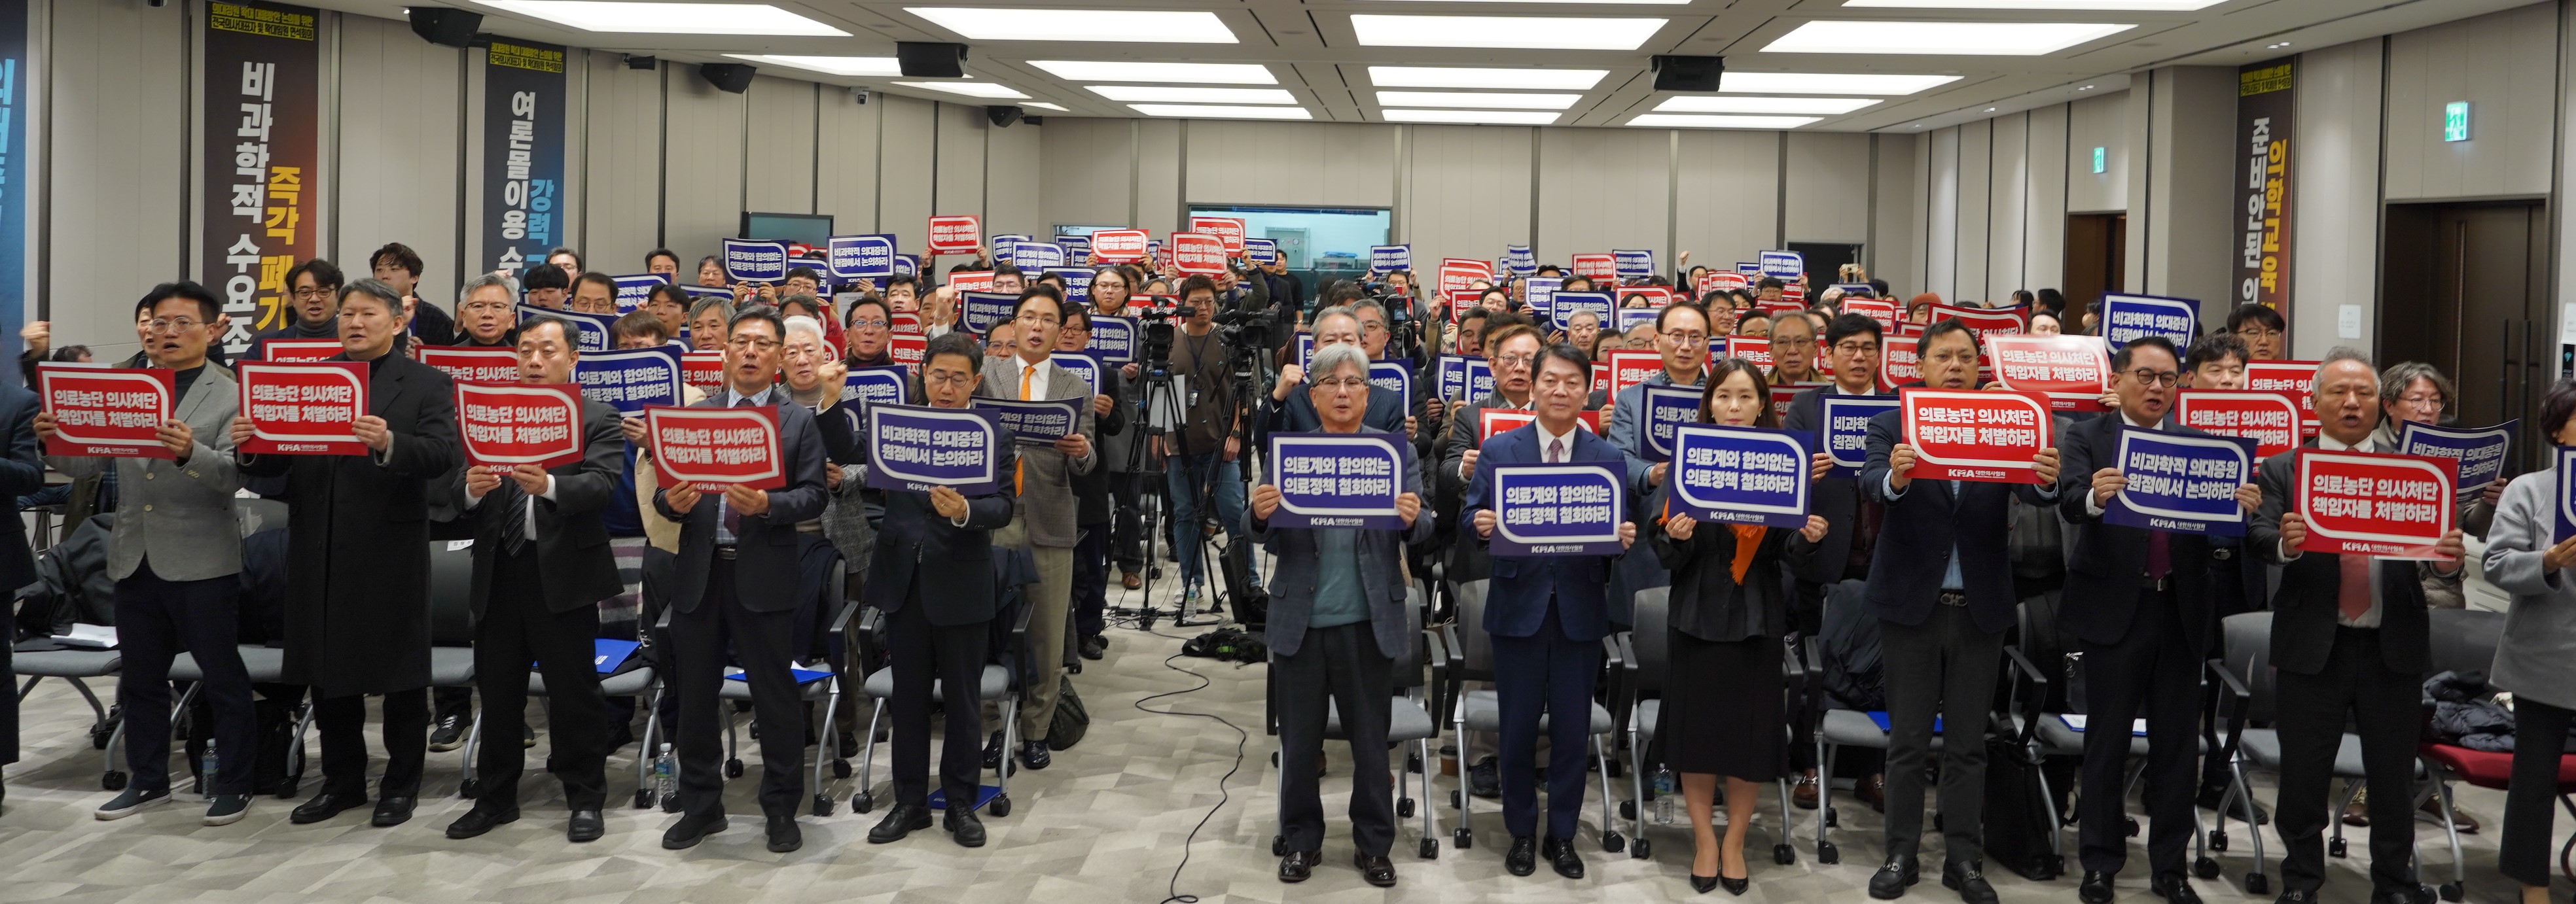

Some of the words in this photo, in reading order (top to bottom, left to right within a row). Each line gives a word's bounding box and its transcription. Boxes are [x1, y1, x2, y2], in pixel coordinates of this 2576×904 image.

[231, 61, 275, 223] 비과학적
[501, 91, 536, 240] 여론몰이용
[2244, 116, 2270, 268] 준비안된
[265, 166, 300, 245] 즉각
[528, 179, 554, 246] 강력
[2260, 139, 2287, 294] 의학교육
[730, 251, 755, 261] 의료계와
[756, 252, 782, 262] 합의없는
[834, 247, 861, 256] 비과학적
[861, 246, 888, 256] 의대증원
[730, 261, 755, 271] 의료정책
[756, 262, 782, 272] 철회하라
[834, 258, 861, 268] 원점에서
[861, 256, 888, 267] 논의하라
[222, 234, 260, 365] 수요조
[970, 302, 998, 315] 비과학적
[2112, 311, 2155, 328] 비과학적
[2155, 314, 2189, 332] 의대증원
[1100, 328, 1128, 339] 합의없는
[1889, 351, 1917, 364] 의료농
[2002, 350, 2048, 364] 의료농단
[2050, 351, 2095, 365] 의사처단
[578, 369, 622, 386] 의료계와
[624, 366, 669, 383] 합의없는
[694, 370, 723, 383] 의사처
[2005, 366, 2050, 381] 책임자를
[2052, 367, 2098, 382] 처벌하라
[252, 384, 300, 402] 의료농단
[301, 385, 352, 403] 의사처단
[625, 382, 670, 401] 철회하라
[2251, 378, 2294, 391] 의료농단
[54, 390, 103, 408] 의료농단
[106, 391, 158, 409] 의사처단
[56, 409, 107, 426] 책임자를
[108, 411, 158, 428] 처벌하라
[253, 404, 300, 422] 책임자를
[302, 406, 352, 423] 처벌하라
[467, 404, 512, 423] 의료농단
[516, 406, 567, 423] 의사처단
[1024, 413, 1067, 425] 합의없는
[1918, 408, 1975, 424] 의료농단
[1978, 409, 2035, 425] 의사처단
[2190, 409, 2239, 426] 의료농단
[2241, 410, 2289, 427] 의사처단
[467, 423, 513, 443] 책임자를
[516, 425, 568, 444] 처벌하라
[1834, 416, 1868, 432] 비과학
[662, 428, 711, 445] 의료농단
[713, 427, 764, 445] 의사처단
[881, 425, 931, 446] 비과학적
[932, 430, 984, 447] 의대증원
[1833, 434, 1866, 450] 원점에
[1920, 426, 1976, 445] 책임자를
[1978, 428, 2036, 447] 처벌하라
[664, 445, 713, 464] 책임자를
[715, 446, 767, 464] 처벌하라
[881, 443, 930, 465] 원점에서
[932, 449, 984, 466] 논의하라
[1687, 447, 1740, 468] 의료계와
[1742, 451, 1796, 473] 합의없는
[2465, 442, 2504, 462] 의대증원
[1284, 457, 1336, 474] 의료계와
[1338, 457, 1391, 475] 합의없는
[1948, 469, 1975, 478] KMA
[2129, 451, 2187, 477] 비과학적
[2189, 458, 2239, 479] 의대증원
[2460, 459, 2499, 478] 논의하라
[1284, 477, 1336, 495] 의료정책
[1338, 478, 1391, 496] 철회하라
[1685, 469, 1739, 491] 의료정책
[1740, 472, 1795, 494] 철회하라
[2127, 472, 2184, 498] 원점에서
[2186, 479, 2236, 500] 논의하라
[2313, 474, 2374, 496] 의료농단
[2376, 479, 2439, 501] 의사처단
[1506, 486, 1558, 504] 의료계와
[1560, 485, 1611, 504] 합의없는
[1506, 506, 1557, 525] 의료정책
[1559, 505, 1611, 524] 철회하라
[2312, 496, 2372, 519] 책임자를
[2375, 501, 2437, 523] 처벌하라
